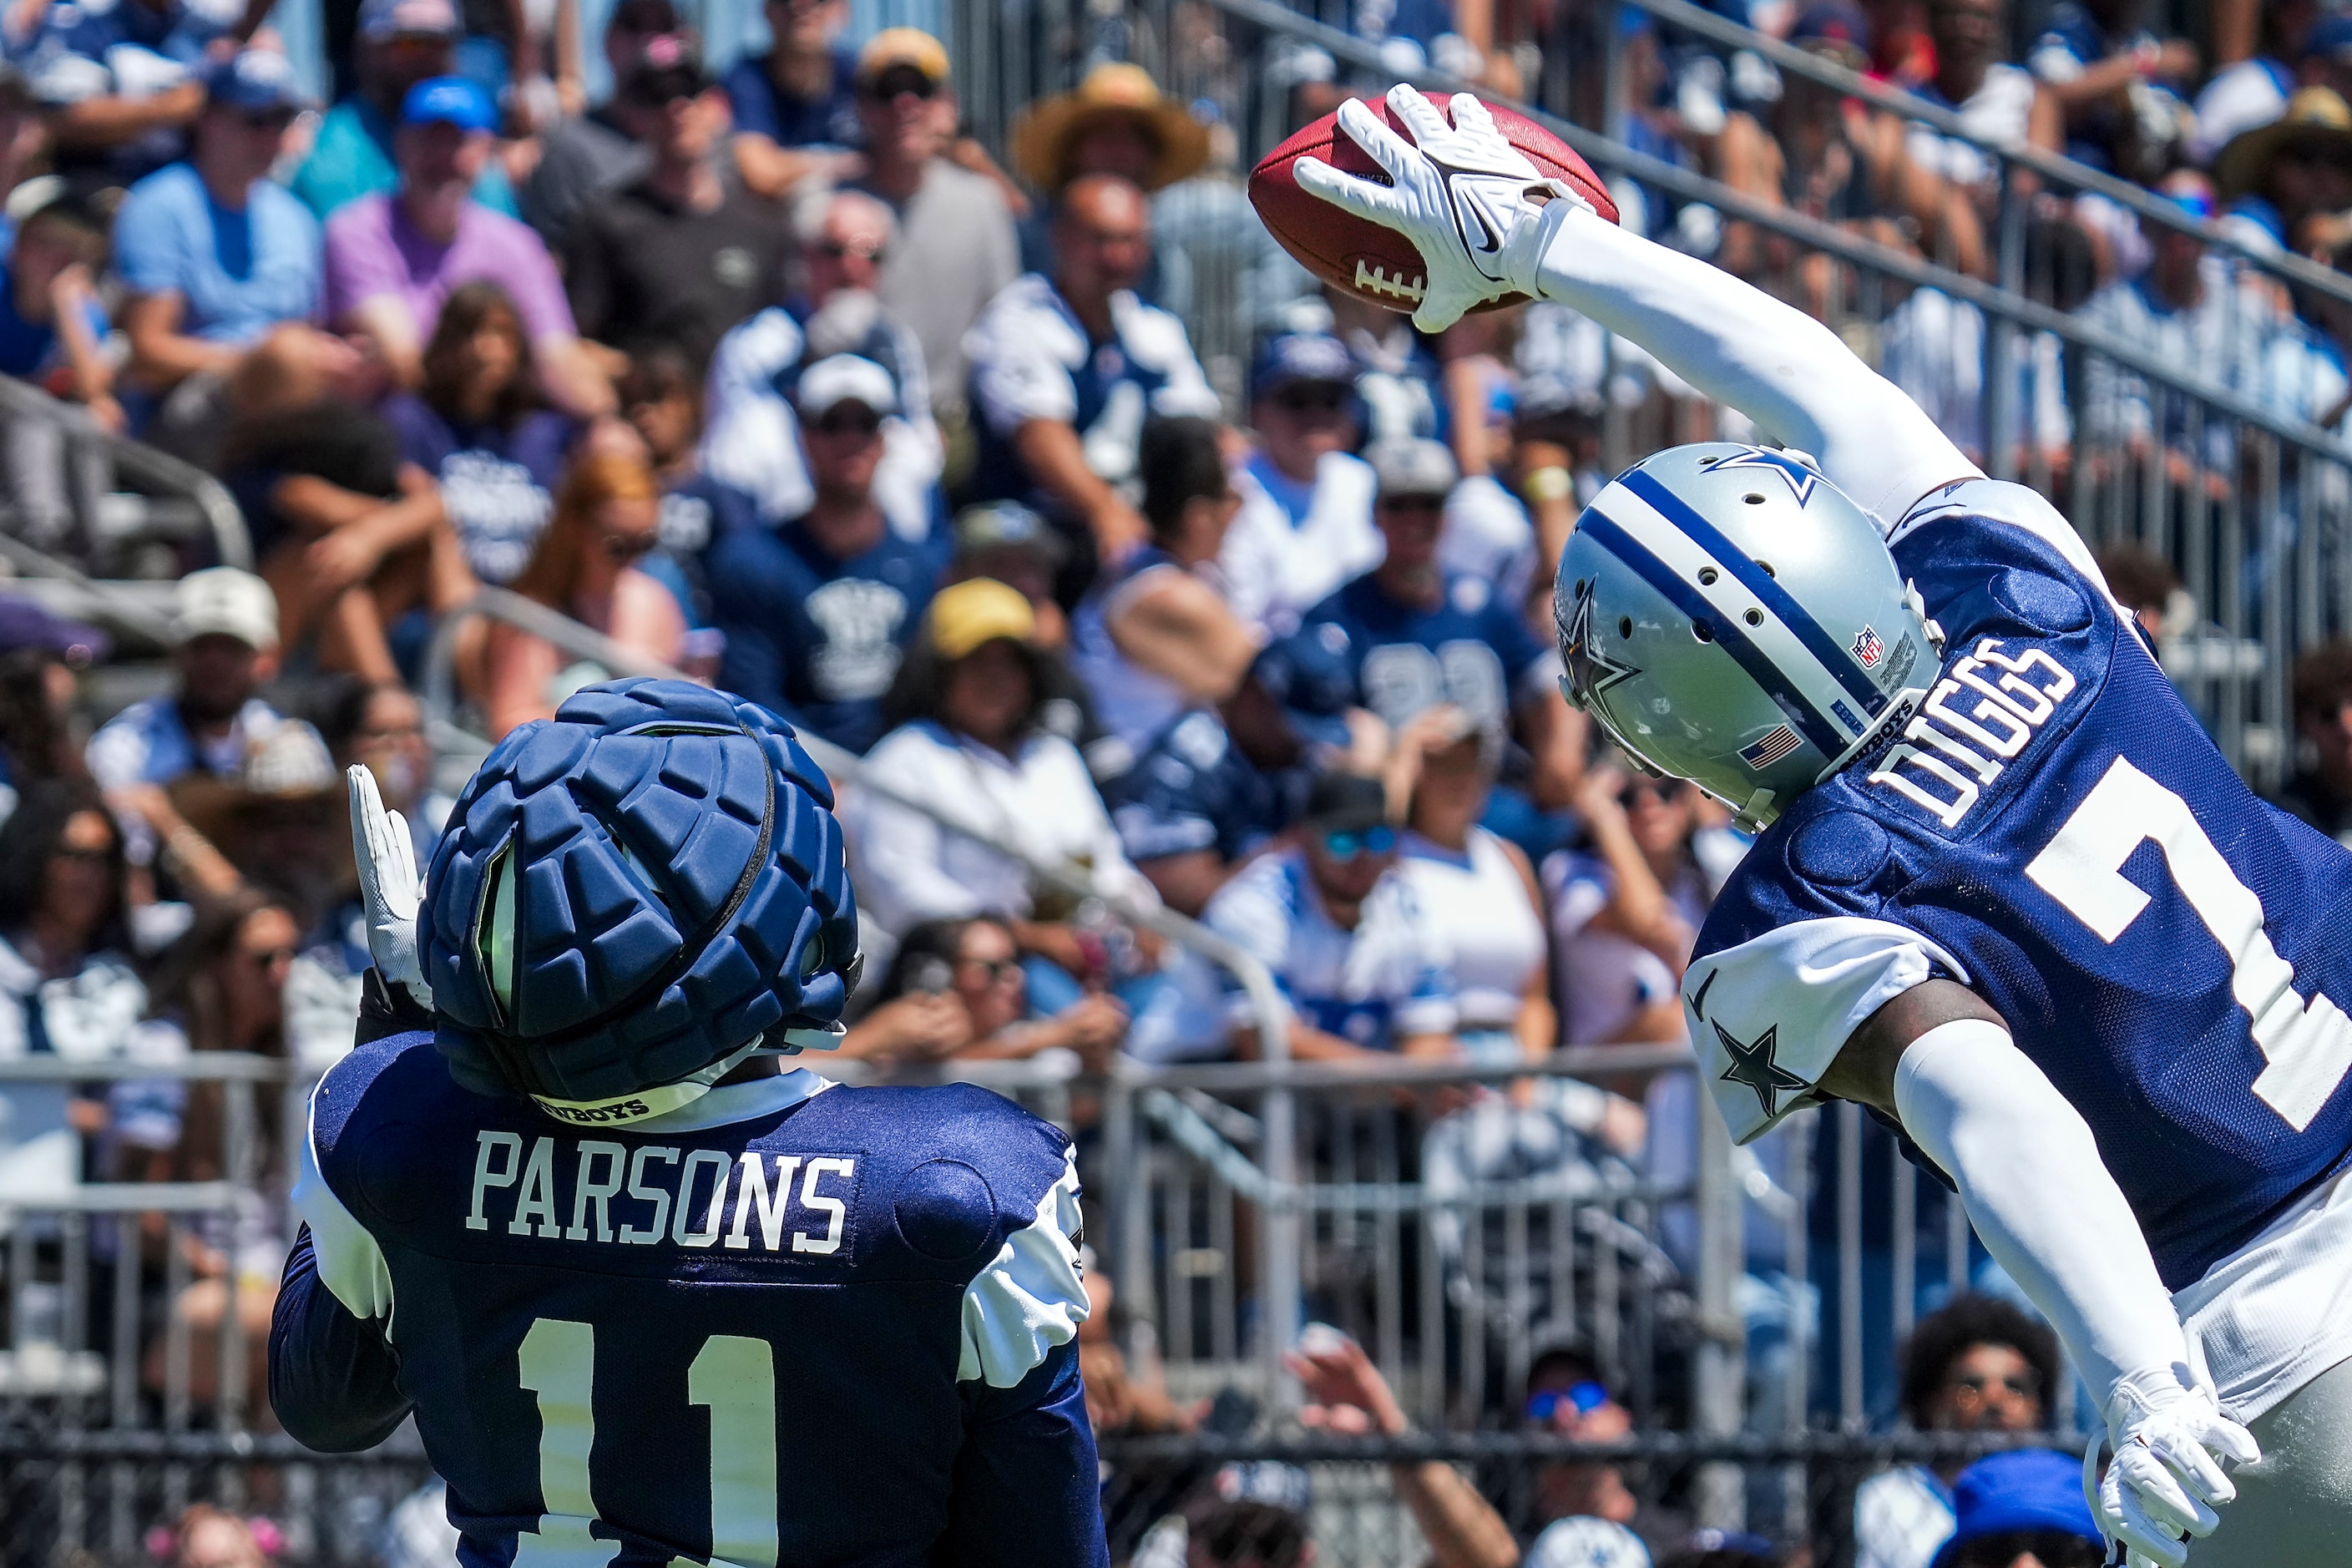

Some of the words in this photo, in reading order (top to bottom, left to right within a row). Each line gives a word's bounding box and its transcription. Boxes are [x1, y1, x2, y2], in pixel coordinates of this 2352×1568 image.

[1861, 640, 1881, 665] NFL
[1828, 698, 1913, 778] OWBOYS
[1867, 638, 2076, 828] DIGGS
[2025, 754, 2352, 1133] 7
[537, 1099, 650, 1121] WBOYS
[466, 1130, 854, 1254] PARSONS
[510, 1317, 779, 1568] 11
